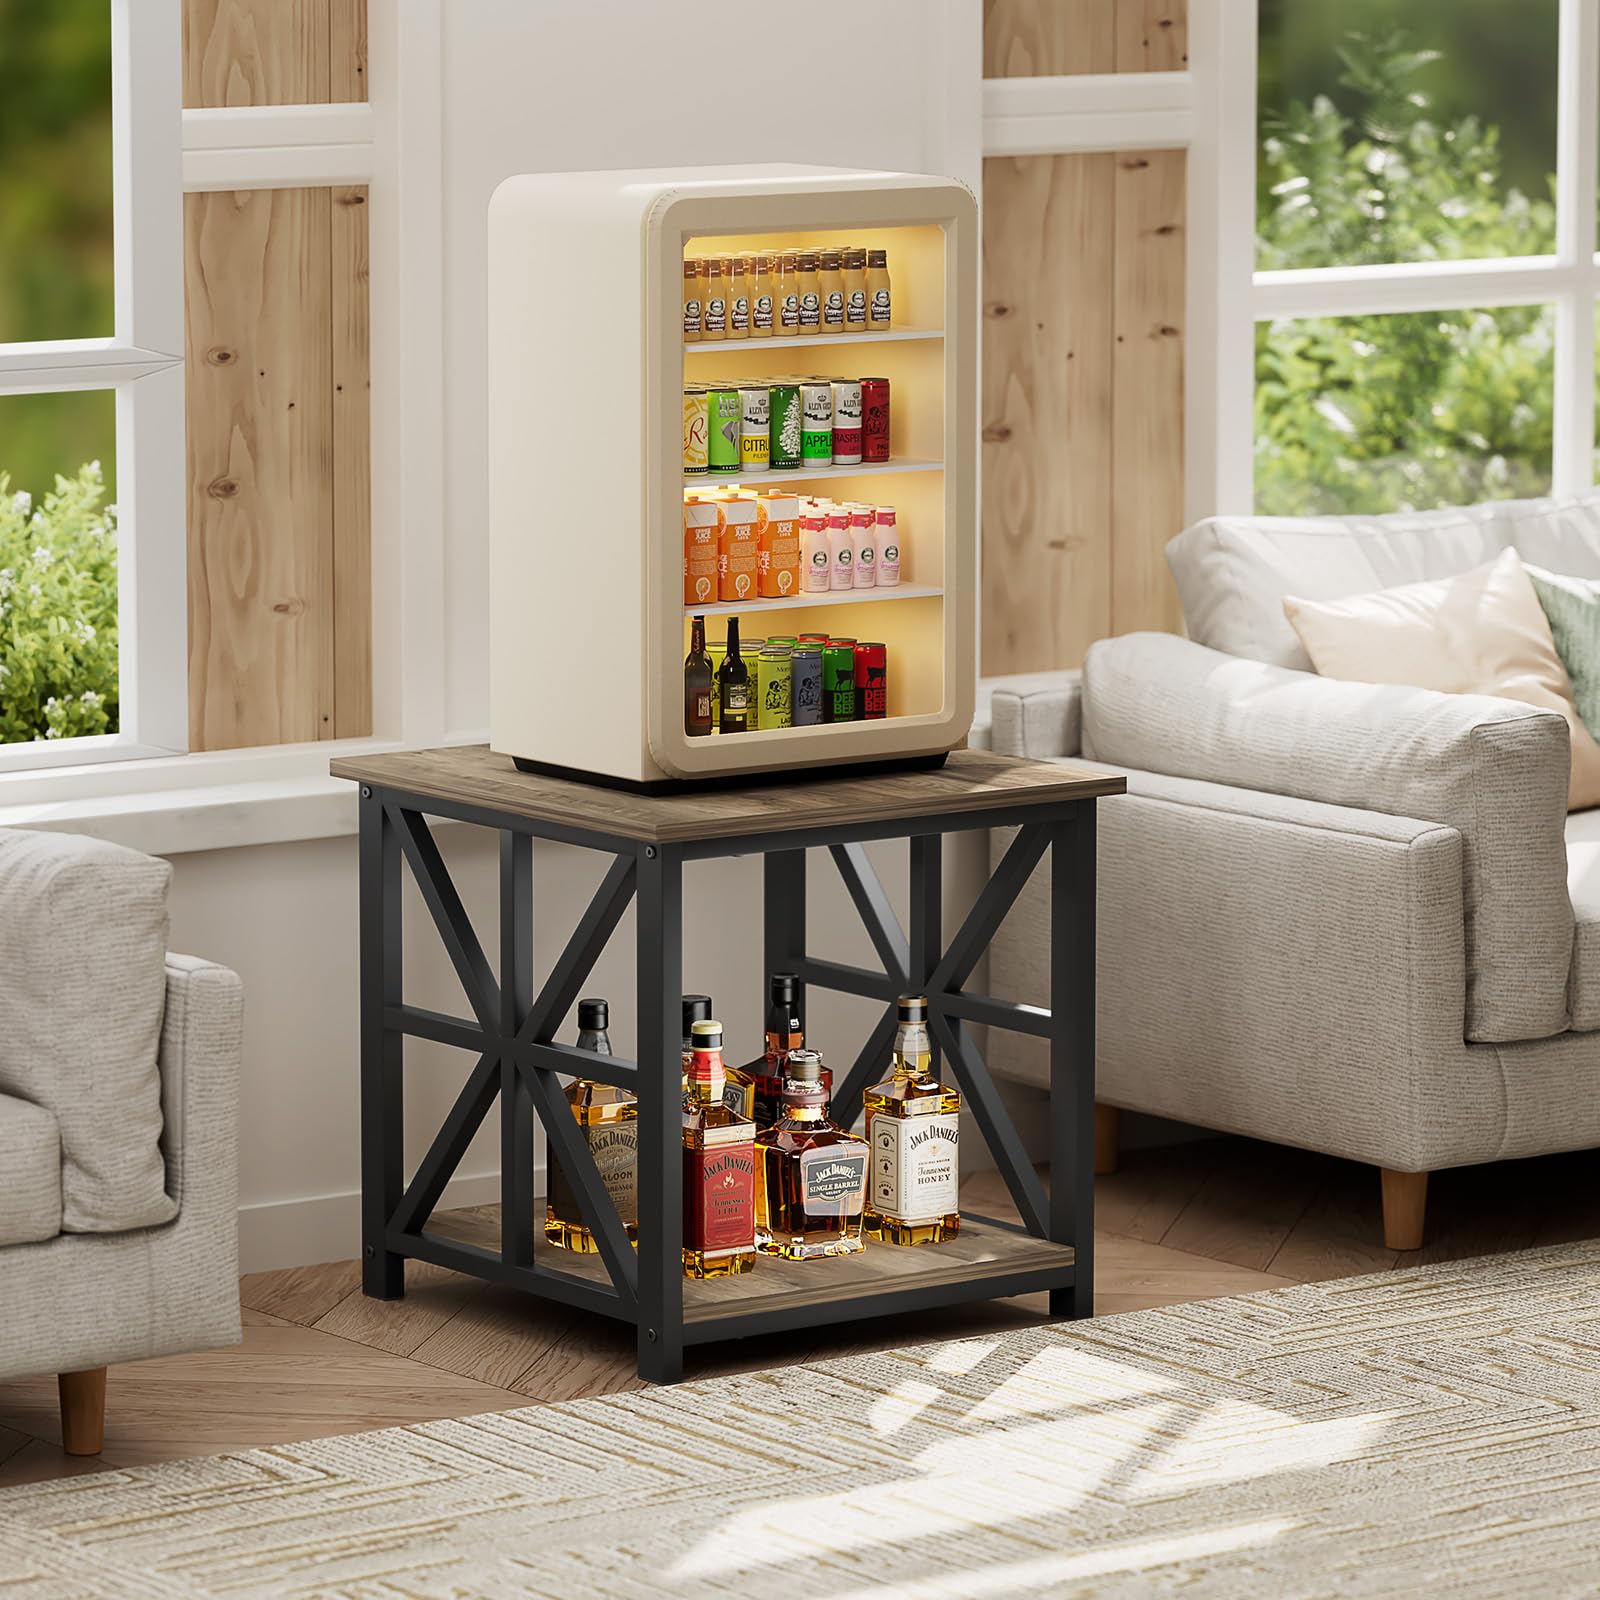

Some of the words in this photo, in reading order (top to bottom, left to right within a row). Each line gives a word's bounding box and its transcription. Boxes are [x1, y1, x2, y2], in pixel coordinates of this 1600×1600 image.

[910, 1130, 930, 1150] JACK
[930, 1124, 959, 1145] DANIEL'S
[590, 1135, 609, 1157] JACK
[602, 1170, 633, 1181] ALOON
[704, 1160, 724, 1181] JACK
[815, 1167, 832, 1184] JACK
[831, 1163, 856, 1179] DANIEL'S
[918, 1166, 950, 1176] Tennessee
[918, 1173, 951, 1185] HONEY
[810, 1184, 833, 1193] SINGLE
[834, 1180, 860, 1190] BARREL
[712, 1198, 745, 1207] Tennessee
[718, 1207, 739, 1215] FIRE
